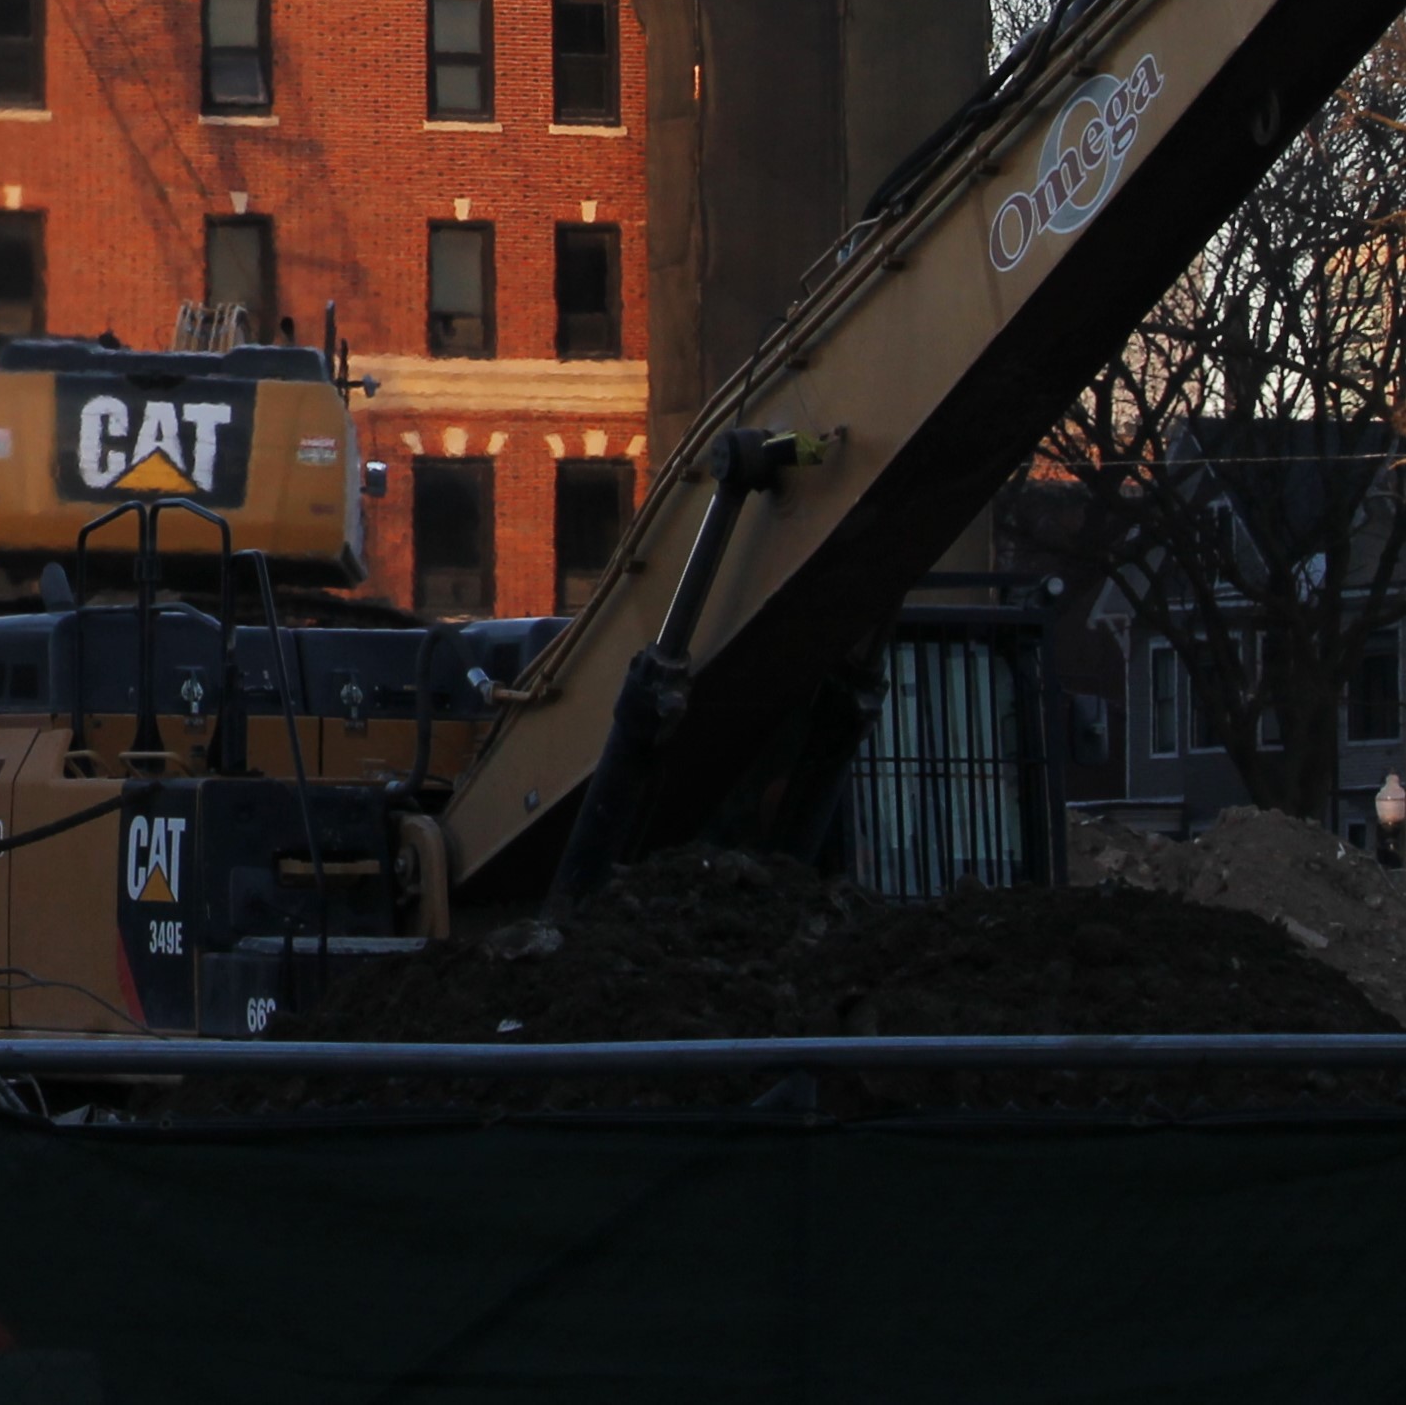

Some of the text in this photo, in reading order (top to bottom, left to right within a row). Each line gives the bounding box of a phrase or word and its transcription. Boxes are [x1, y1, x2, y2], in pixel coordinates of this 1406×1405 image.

[989, 53, 1165, 272] Omega
[78, 395, 231, 493] CAT
[128, 816, 186, 902] CAT
[149, 920, 183, 956] 349E
